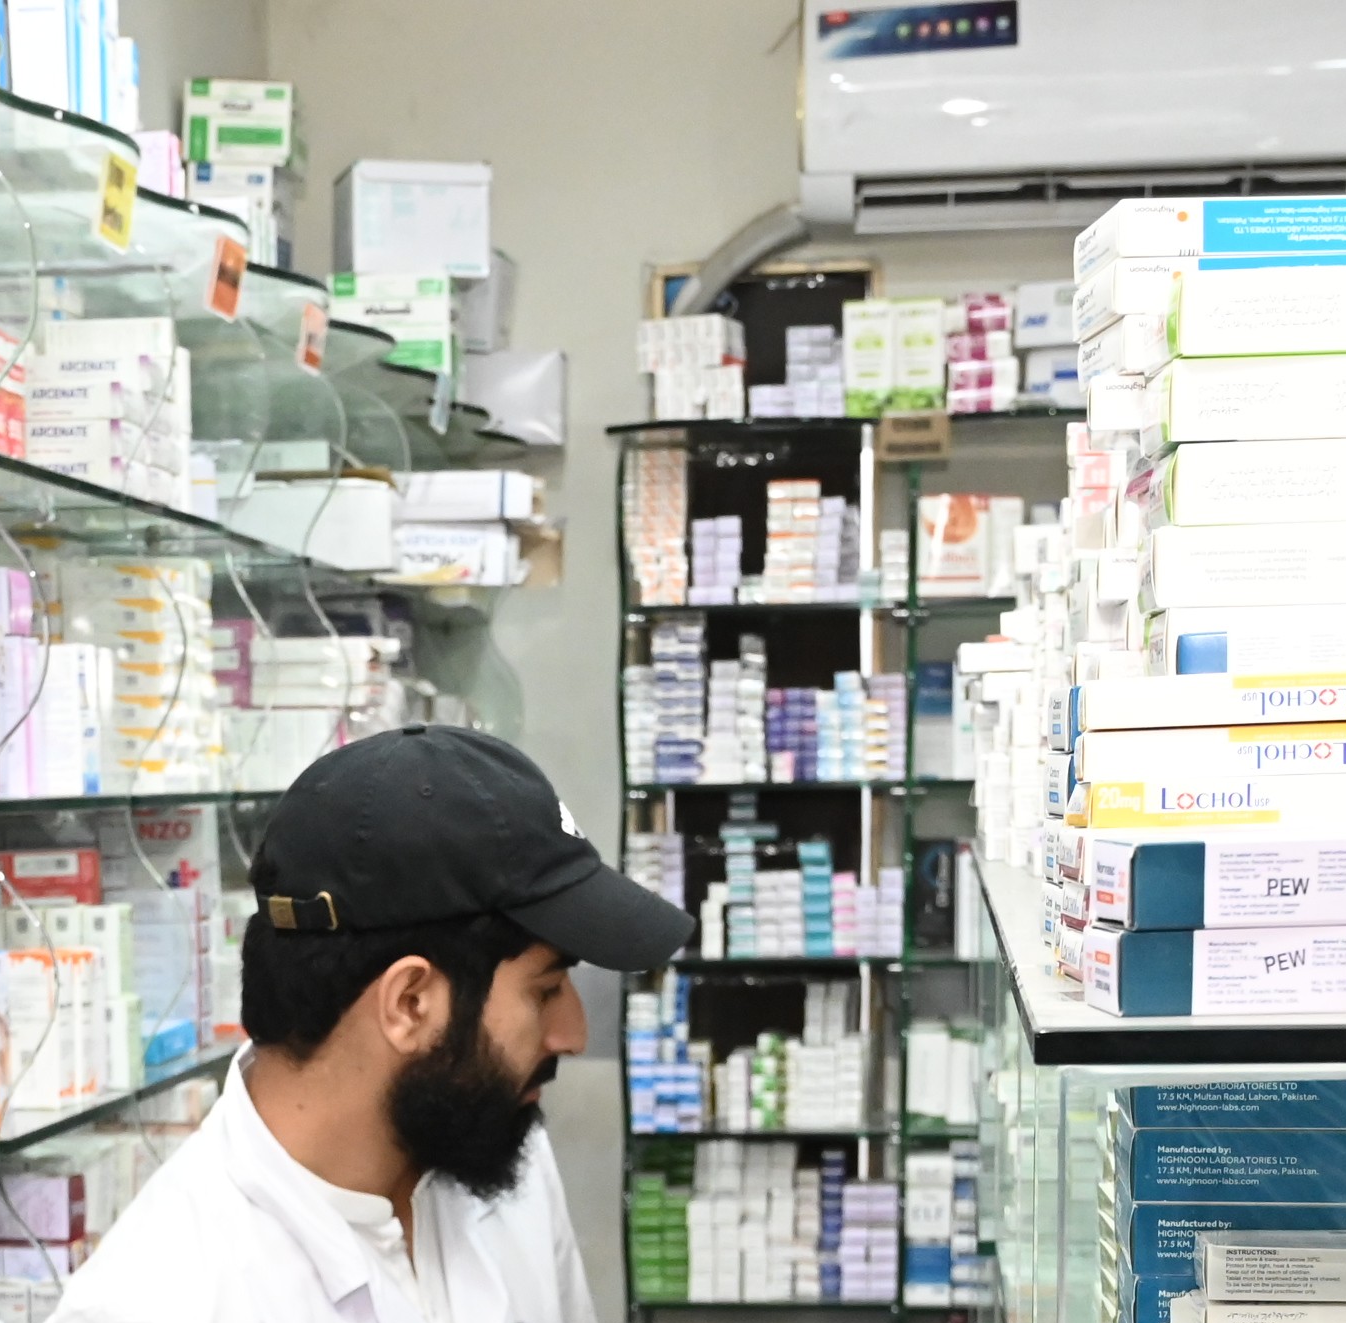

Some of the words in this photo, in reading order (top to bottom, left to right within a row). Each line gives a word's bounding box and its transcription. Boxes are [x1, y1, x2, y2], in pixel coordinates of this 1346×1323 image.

[1097, 788, 1140, 811] 20mg
[1266, 877, 1309, 897] PEW
[1263, 950, 1306, 974] PEW
[1158, 1145, 1217, 1154] Manufactured
[1219, 1145, 1231, 1156] by:
[1157, 1156, 1208, 1165] HIGHNOON
[1209, 1156, 1279, 1166] LABORATORIES
[1279, 1157, 1298, 1166] LTD
